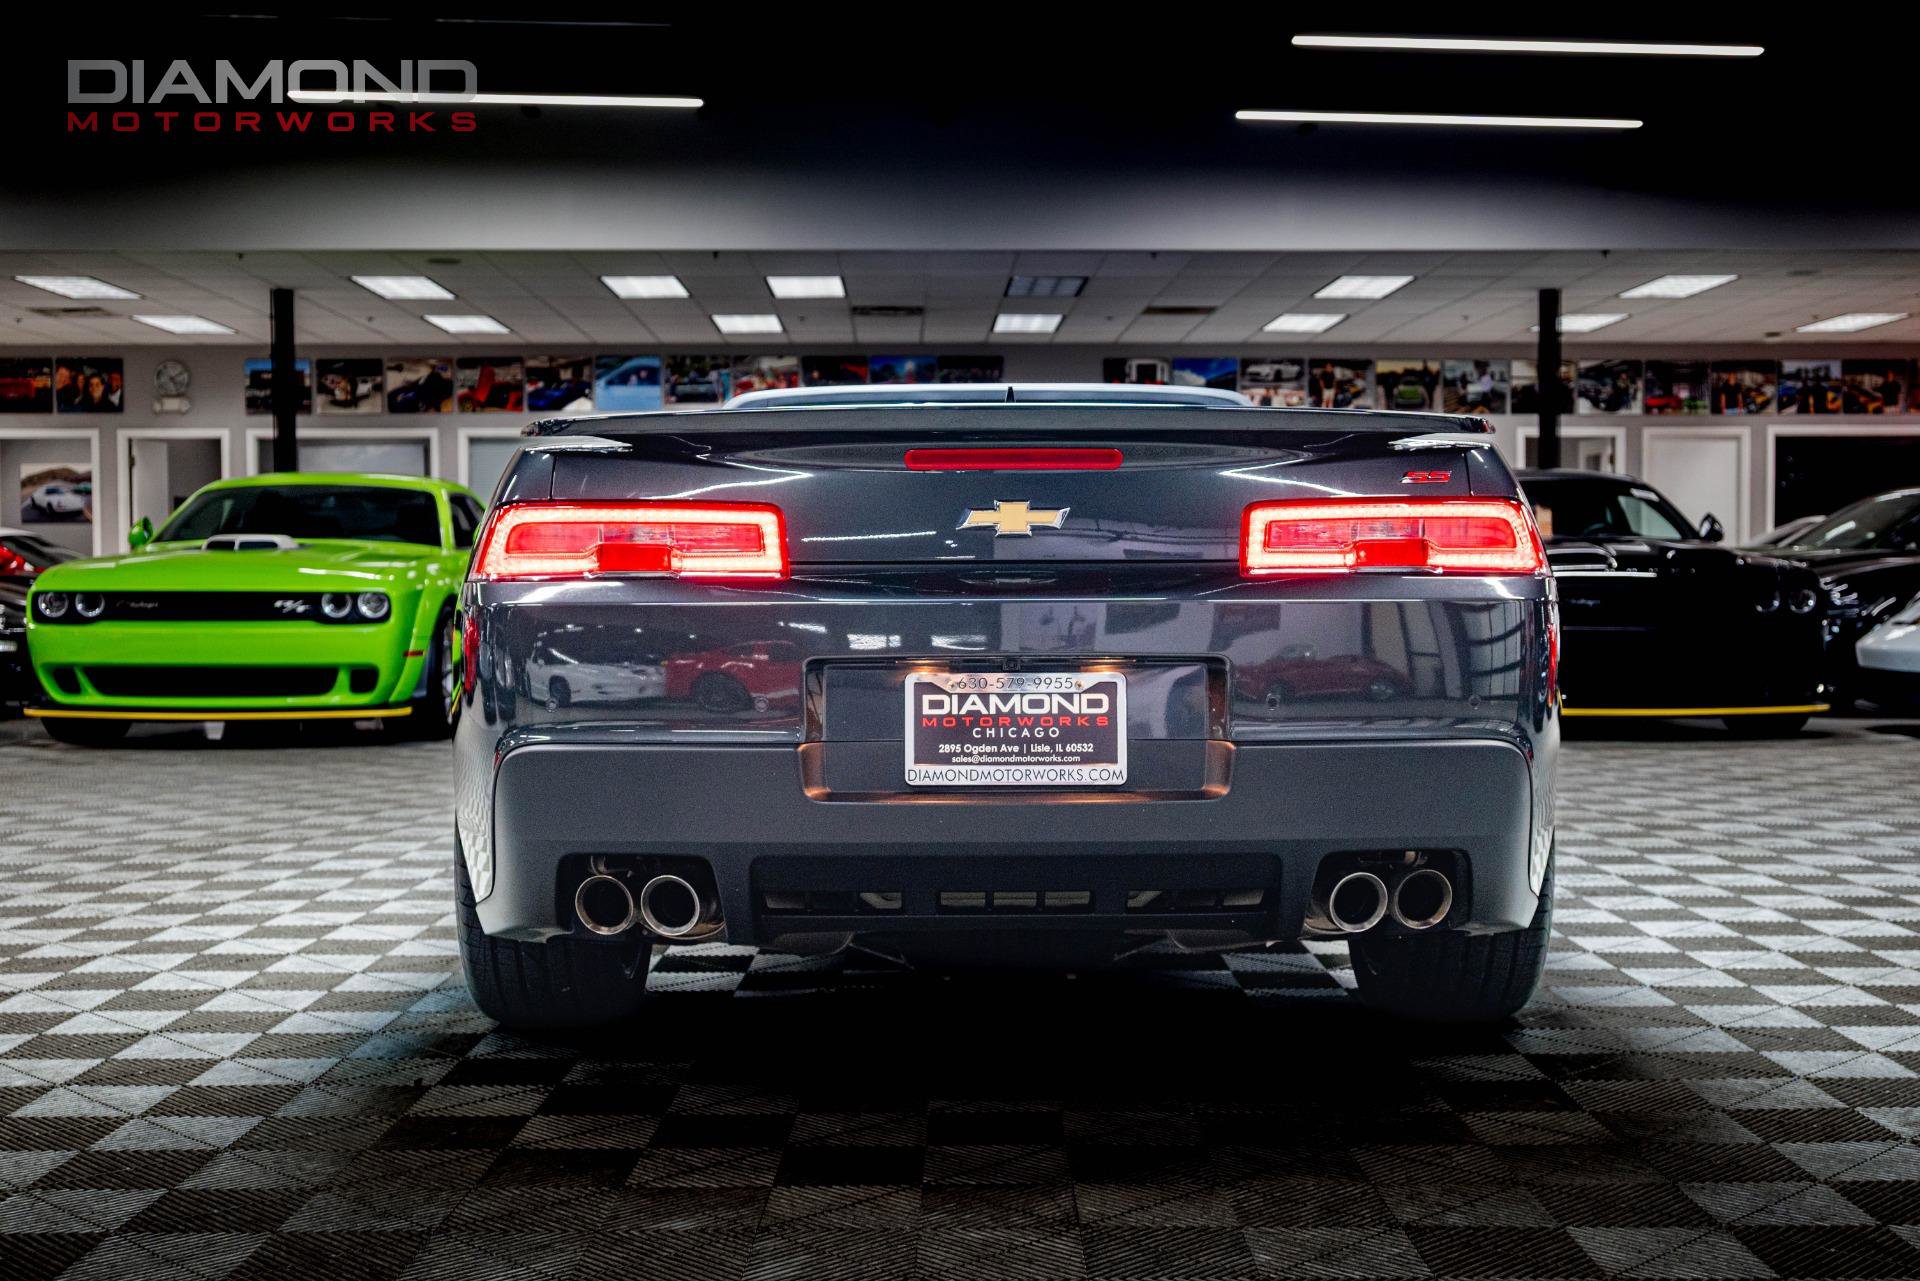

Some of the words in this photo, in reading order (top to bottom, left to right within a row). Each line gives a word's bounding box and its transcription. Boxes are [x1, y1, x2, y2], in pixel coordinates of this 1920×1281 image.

[958, 677, 1073, 690] 630-579-9955
[922, 694, 1109, 715] DIAMOND
[922, 716, 1109, 727] MOTORWORKS
[972, 727, 1060, 738] CHICAGO
[938, 744, 962, 753] 2895
[963, 744, 998, 754] Ogden
[999, 744, 1020, 753] Ave
[1030, 743, 1053, 753] Lisle,
[1055, 743, 1063, 752] IL
[1065, 743, 1094, 752] 60532
[951, 754, 1081, 763] sales@diamondmotorworks.com
[907, 769, 1124, 781] DIAMONDMOTORWORKS.COM
